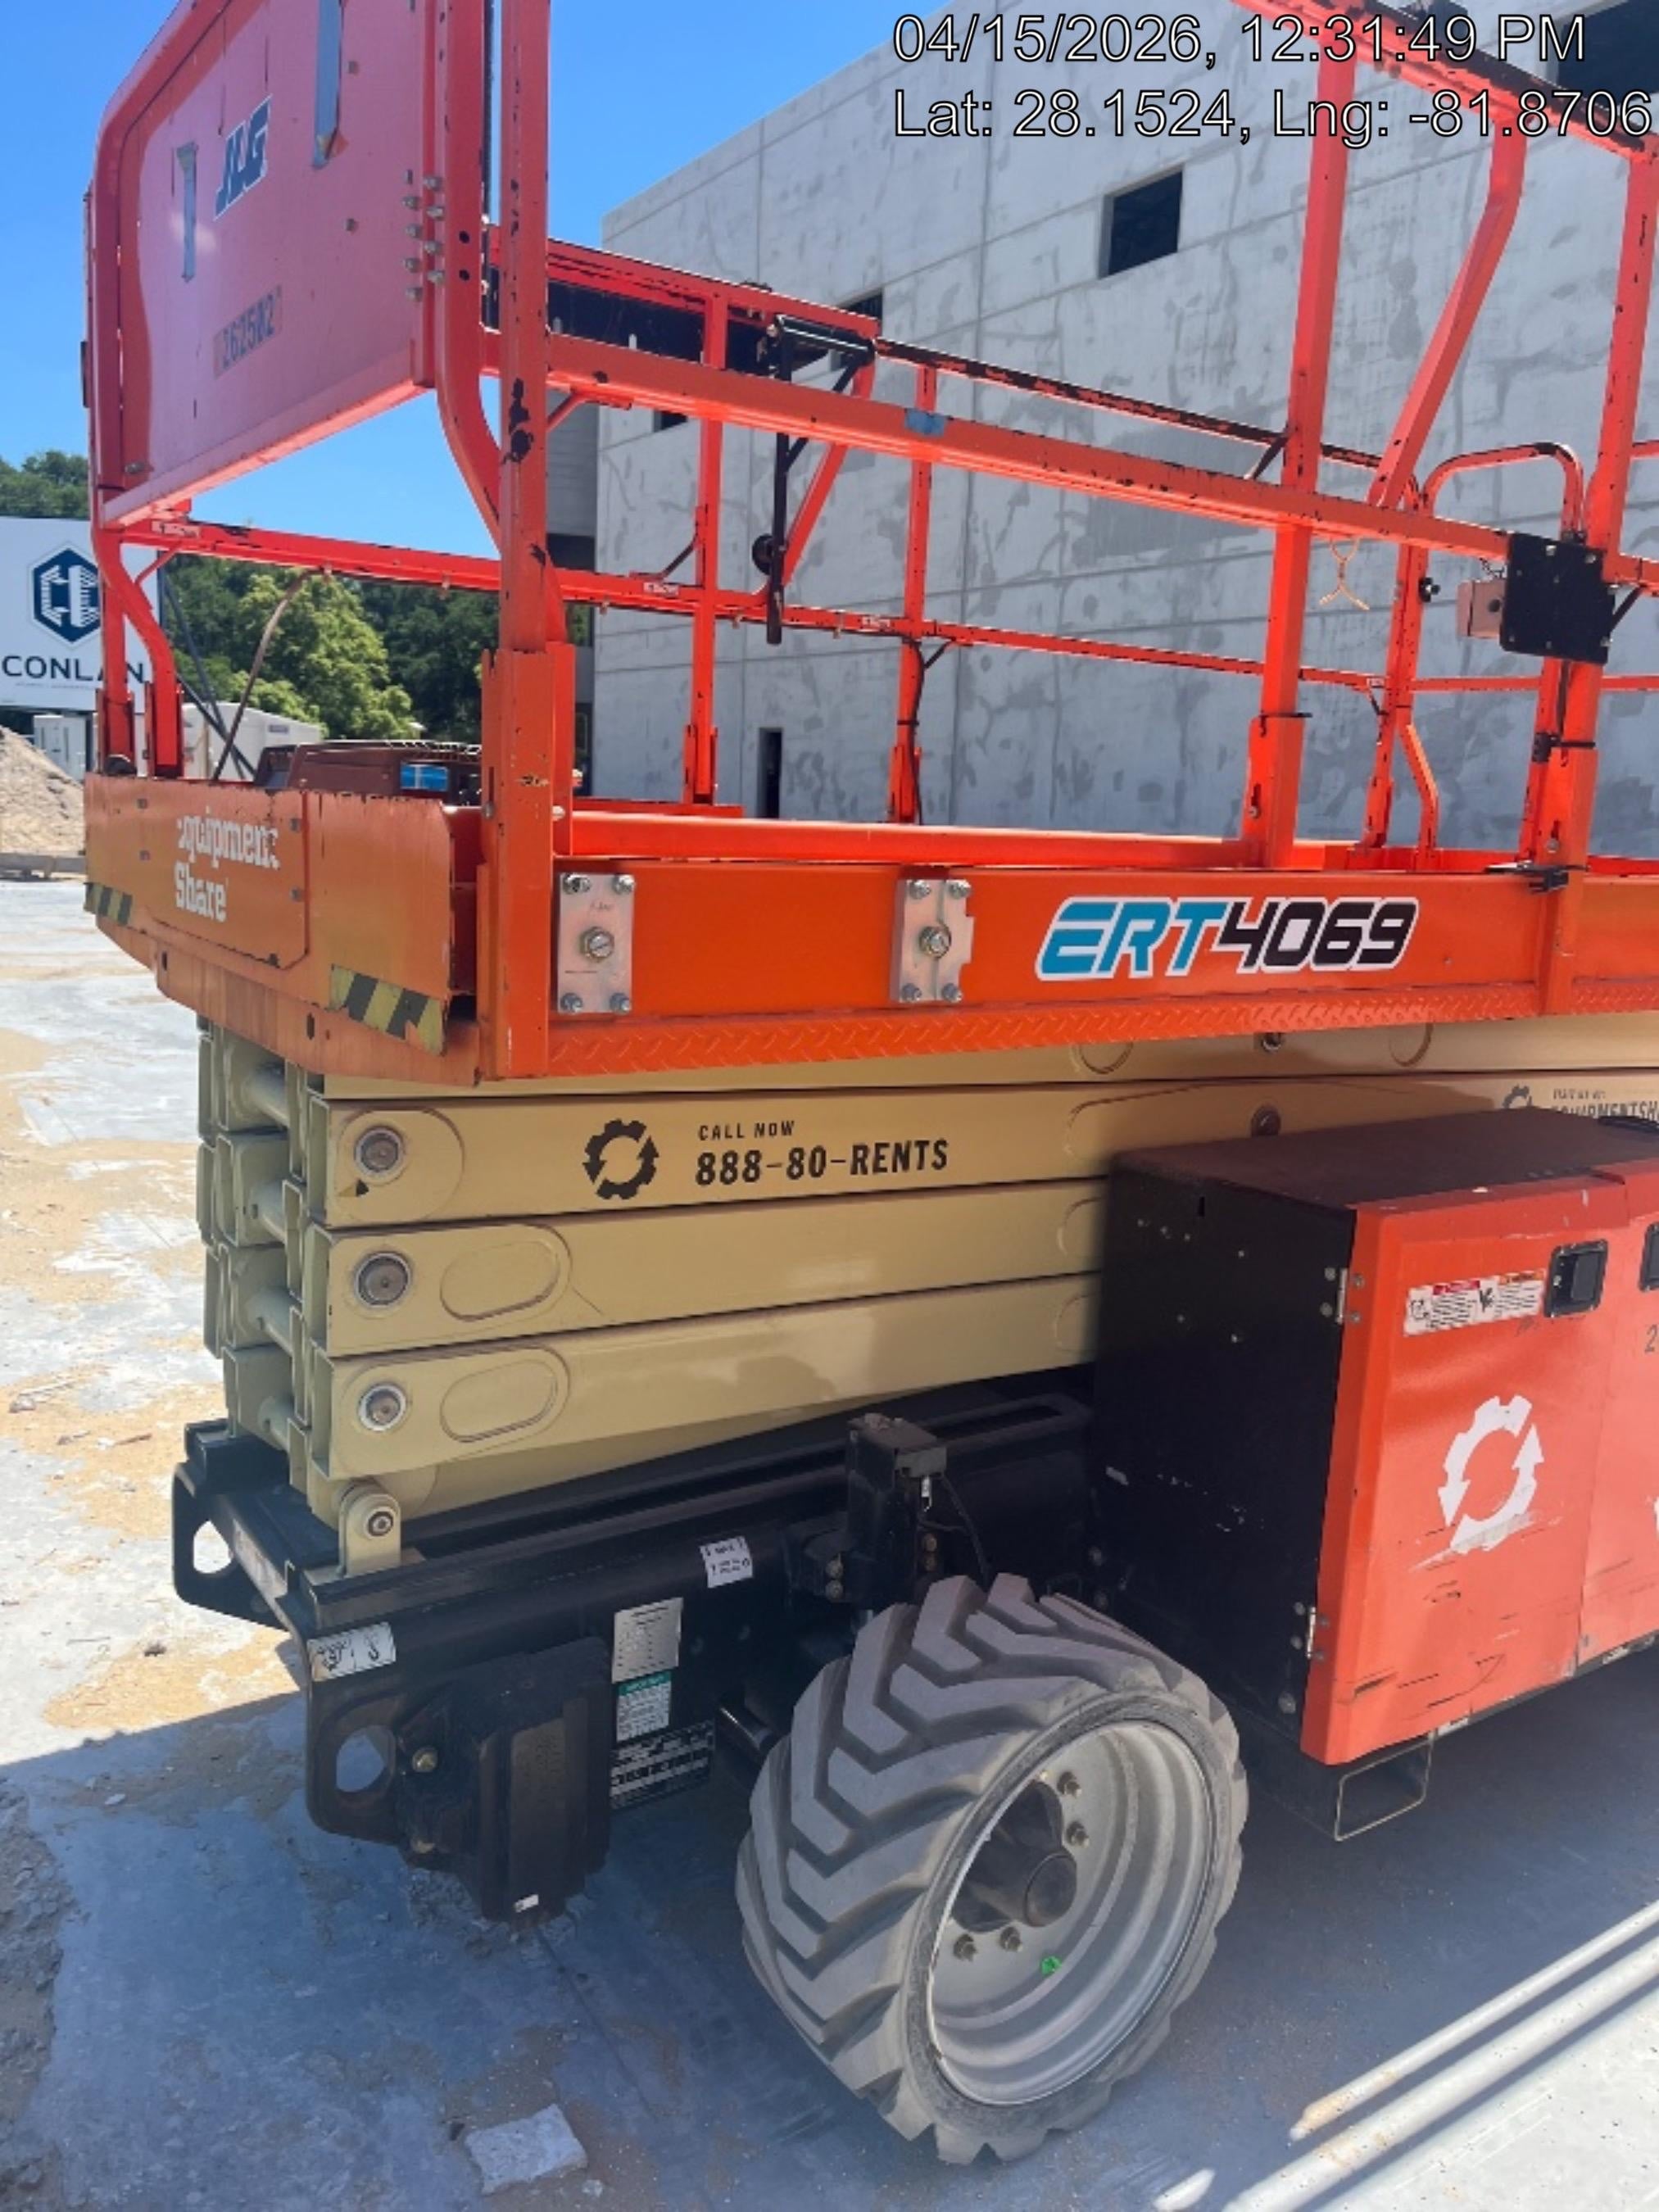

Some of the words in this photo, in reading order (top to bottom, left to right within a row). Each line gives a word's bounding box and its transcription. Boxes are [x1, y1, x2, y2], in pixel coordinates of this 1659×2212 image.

[214, 96, 272, 219] JLG
[2, 655, 143, 684] CONLN
[175, 859, 227, 922] Share
[1036, 897, 1419, 981] ERT4069
[699, 1125, 745, 1141] CALL
[754, 1120, 795, 1138] NOW
[696, 1137, 949, 1185] 888-80-RENTS
